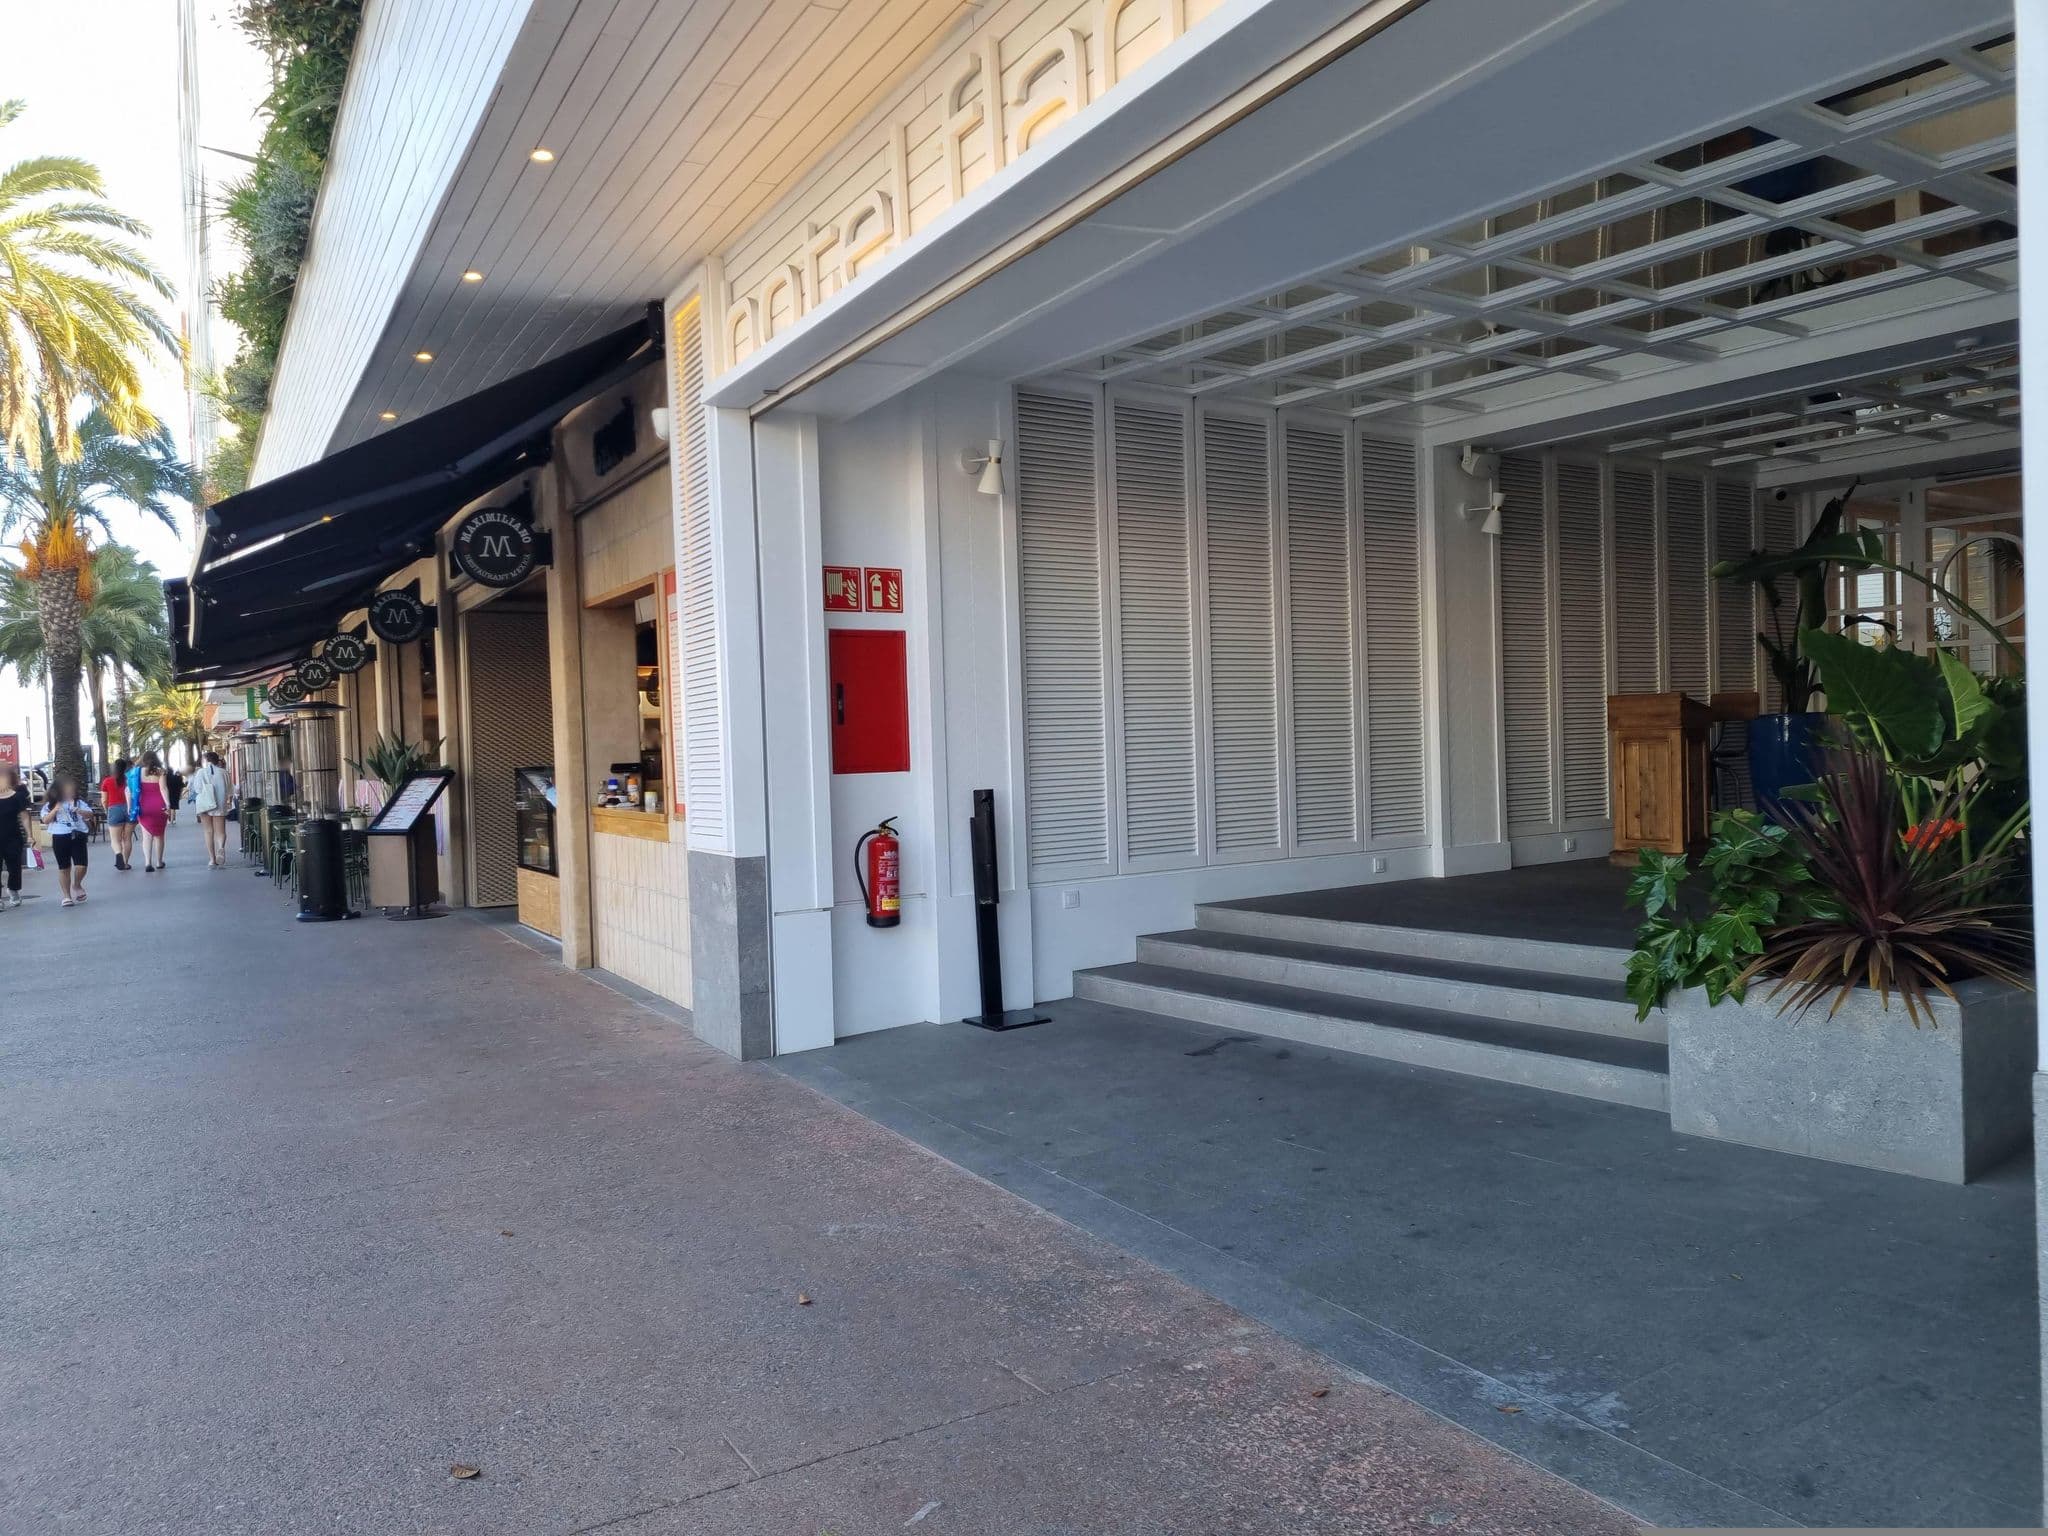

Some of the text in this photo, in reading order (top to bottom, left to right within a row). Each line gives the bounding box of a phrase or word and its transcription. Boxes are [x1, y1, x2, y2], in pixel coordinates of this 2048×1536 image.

[719, 120, 911, 373] hotel
[460, 512, 532, 544] MAXIMILIANO
[479, 535, 517, 558] M
[372, 592, 424, 615] MAXIMILIANO
[384, 608, 411, 624] M
[335, 646, 357, 659] M
[306, 669, 324, 680] M
